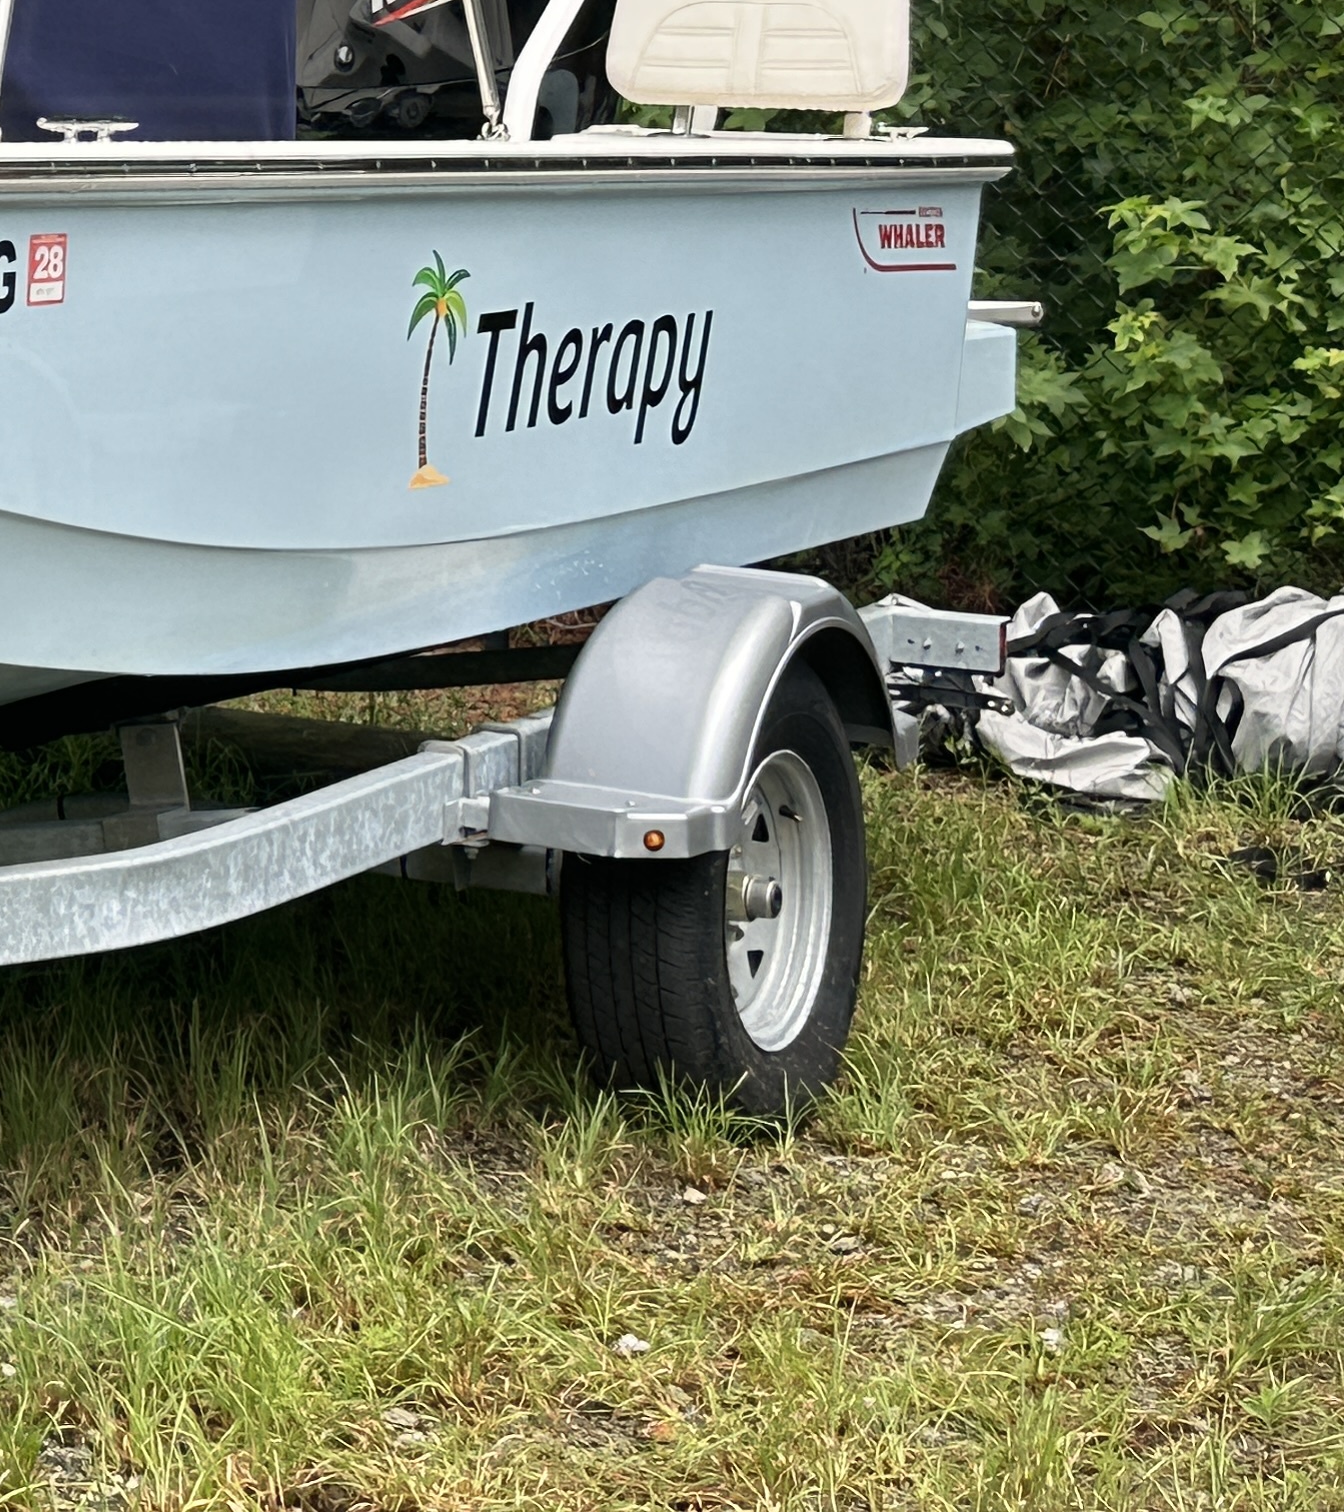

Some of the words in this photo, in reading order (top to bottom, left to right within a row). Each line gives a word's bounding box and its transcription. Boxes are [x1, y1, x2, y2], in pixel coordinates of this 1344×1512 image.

[878, 223, 946, 249] WHALER
[33, 244, 64, 280] 28
[474, 301, 714, 445] Therapy
